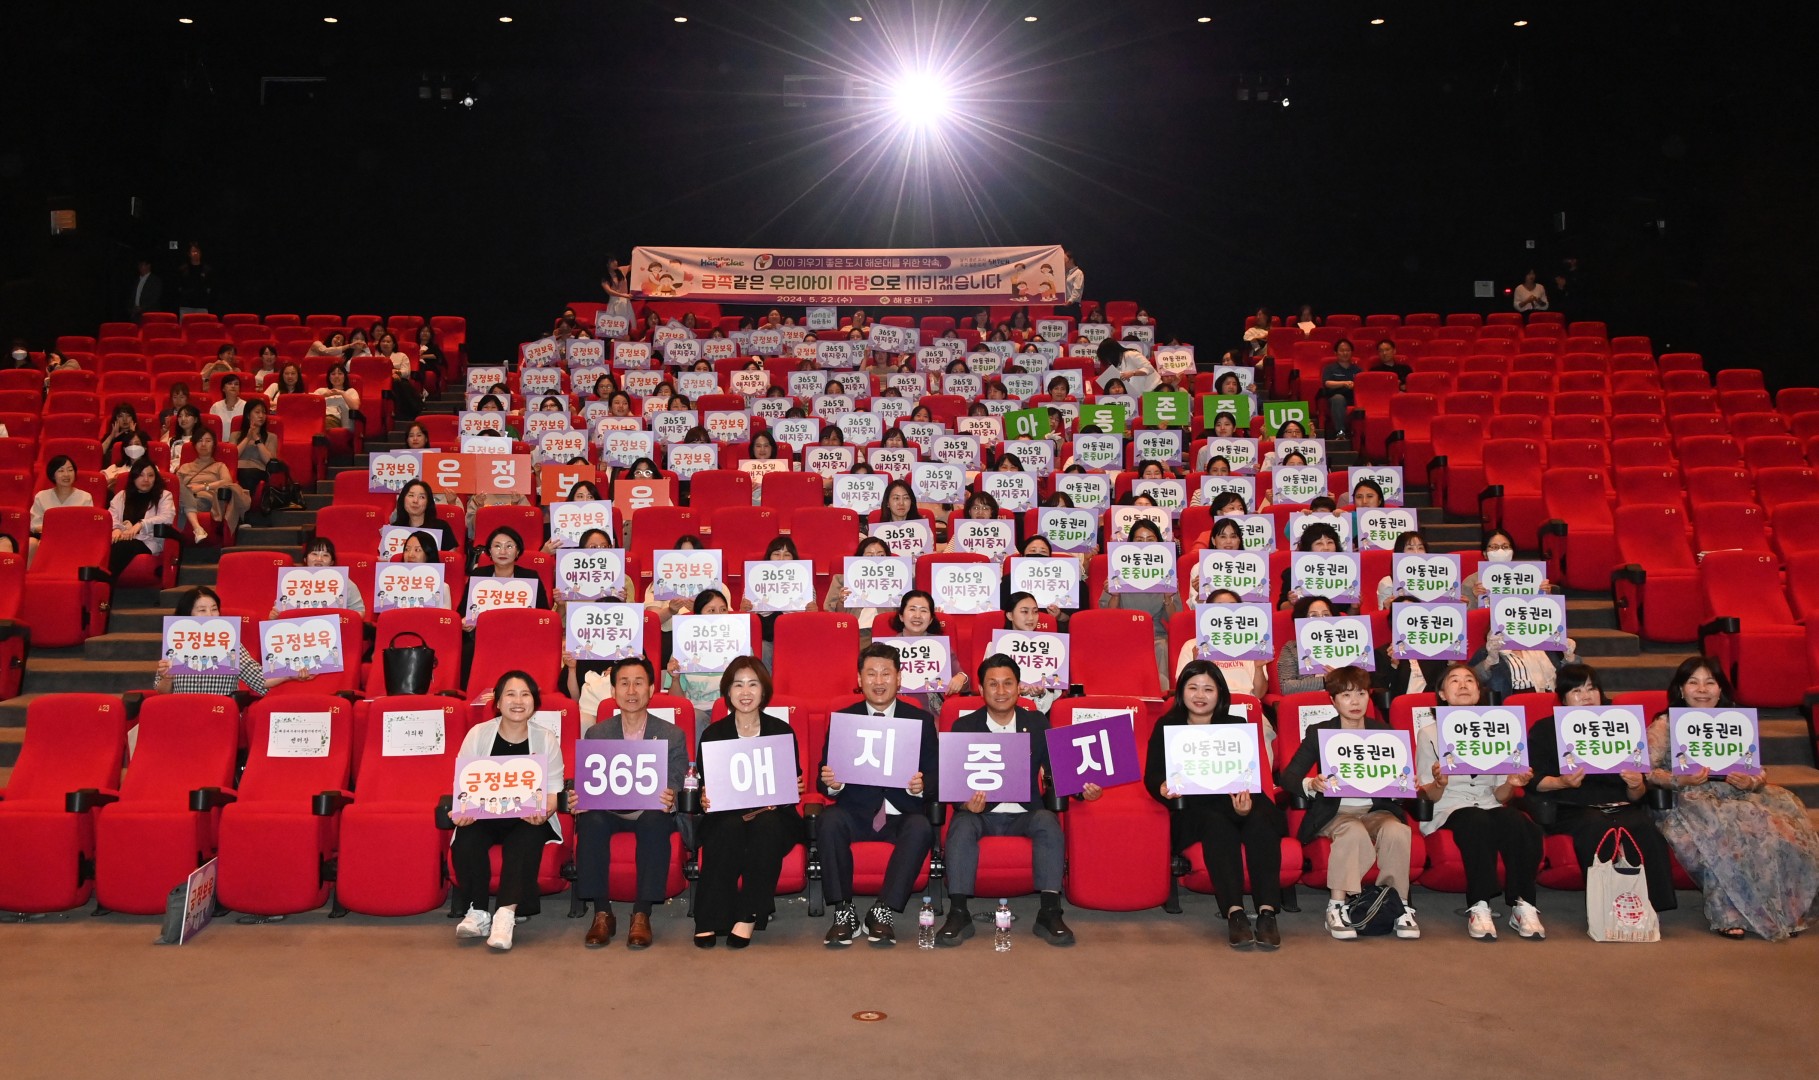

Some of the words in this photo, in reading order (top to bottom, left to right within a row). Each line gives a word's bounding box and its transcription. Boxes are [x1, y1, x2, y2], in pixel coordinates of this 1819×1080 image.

[777, 259, 795, 268] 아이
[797, 259, 821, 268] 키우기
[825, 259, 844, 268] 좋은
[845, 259, 863, 268] 도시
[864, 259, 900, 268] 해운대를
[902, 259, 920, 268] 위한
[701, 274, 764, 290] 금쪽같은
[769, 275, 832, 290] 우리아이
[838, 275, 901, 290] 사랑으로
[905, 273, 1002, 290] 지키겠습니다
[893, 297, 934, 305] 해운대구
[600, 319, 625, 329] 긍정보육
[752, 336, 778, 345] 긍정보육
[572, 346, 600, 357] 긍정보육
[618, 348, 646, 358] 긍정보육
[706, 344, 732, 354] 긍정보육
[472, 374, 501, 384] 긍정보육
[526, 374, 556, 384] 긍정보육
[628, 376, 659, 387] 긍정보육
[682, 378, 712, 388] 긍정보육
[1156, 396, 1177, 420] 존
[710, 418, 744, 429] 긍정보육
[848, 418, 871, 426] 365일
[1016, 414, 1039, 436] 아
[1093, 410, 1115, 434] 동
[1270, 408, 1304, 430] UP
[464, 420, 500, 431] 긍정보육
[530, 420, 564, 431] 긍정보육
[784, 424, 808, 432] 365일
[544, 438, 582, 450] 긍정보육
[609, 440, 648, 452] 긍정보육
[944, 442, 968, 450] 365일
[1082, 442, 1114, 450] 아동권리
[1142, 438, 1173, 446] 아동권리
[818, 452, 842, 460] 365일
[1016, 446, 1041, 455] 365일
[1143, 448, 1173, 456] 존중UP!
[1216, 446, 1248, 454] 아동권리
[674, 453, 712, 464] 긍정보육
[880, 454, 905, 462] 365일
[1082, 452, 1114, 461] 존중UP!
[376, 462, 416, 476] 긍정보육
[492, 460, 516, 489] 정
[925, 470, 952, 479] 365일
[556, 473, 579, 497] 보
[996, 478, 1023, 488] 365일
[1282, 474, 1317, 484] 아동권리
[848, 482, 874, 490] 365일
[920, 481, 958, 490] 애지중지
[1066, 482, 1100, 492] 아동권리
[1282, 486, 1317, 495] 존중UP!
[842, 492, 880, 500] 애지중지
[990, 490, 1030, 499] 애지중지
[1142, 488, 1177, 497] 아동권리
[558, 512, 604, 528] 긍정보육
[1048, 518, 1087, 528] 아동권리
[1368, 518, 1407, 528] 아동권리
[885, 528, 915, 540] 365일
[970, 526, 1000, 538] 365일
[1048, 530, 1087, 541] 존중UP!
[963, 538, 1006, 550] 애지중지
[573, 558, 608, 570] 365일
[1120, 554, 1164, 565] 아동권리
[662, 562, 714, 579] 긍정보육
[861, 564, 896, 578] 365일
[1028, 566, 1062, 578] 365일
[1121, 566, 1164, 579] 존중UP!
[1212, 562, 1256, 573] 아동권리
[1304, 564, 1348, 576] 아동권리
[1406, 565, 1448, 576] 아동권리
[566, 570, 615, 583] 애지중지
[762, 569, 796, 582] 365일
[949, 571, 983, 584] 365일
[1491, 573, 1534, 584] 아동권리
[286, 580, 340, 596] 긍정보육
[383, 575, 435, 592] 긍정보육
[754, 582, 803, 594] 애지중지
[854, 578, 903, 591] 애지중지
[1020, 579, 1070, 592] 애지중지
[1212, 576, 1256, 588] 존중UP!
[1304, 578, 1348, 590] 존중UP!
[1406, 579, 1449, 591] 존중UP!
[942, 584, 990, 598] 애지중지
[476, 589, 528, 606] 긍정보육
[586, 612, 624, 626] 365일
[1504, 607, 1552, 620] 아동권리
[1210, 616, 1258, 629] 아동권리
[1406, 616, 1453, 629] 아동권리
[577, 628, 632, 640] 애지중지
[692, 624, 731, 638] 365일
[1505, 622, 1552, 636] 존중UP!
[172, 631, 230, 650] 긍정보육
[270, 630, 331, 654] 긍정보육
[1210, 631, 1259, 646] 존중UP!
[1310, 629, 1359, 643] 아동권리
[1406, 630, 1453, 644] 존중UP!
[683, 640, 740, 653] 애지중지
[1011, 640, 1050, 654] 365일
[1312, 644, 1360, 658] 존중UP!
[1454, 721, 1510, 738] 아동권리
[1572, 720, 1630, 738] 아동권리
[1688, 722, 1742, 739] 아동권리
[854, 728, 896, 776] 지
[1072, 729, 1115, 776] 지
[1182, 740, 1241, 756] 아동권리
[1338, 745, 1396, 760] 아동권리
[1456, 740, 1512, 756] 존중UP!
[1574, 740, 1632, 756] 존중UP!
[1688, 741, 1743, 758] 존중UP!
[730, 746, 776, 796] 애
[964, 744, 1006, 792] 중
[1183, 758, 1243, 777] 존중UP!
[1340, 762, 1398, 780] 존중UP!
[466, 770, 536, 792] 긍정보육
[584, 754, 658, 796] 365
